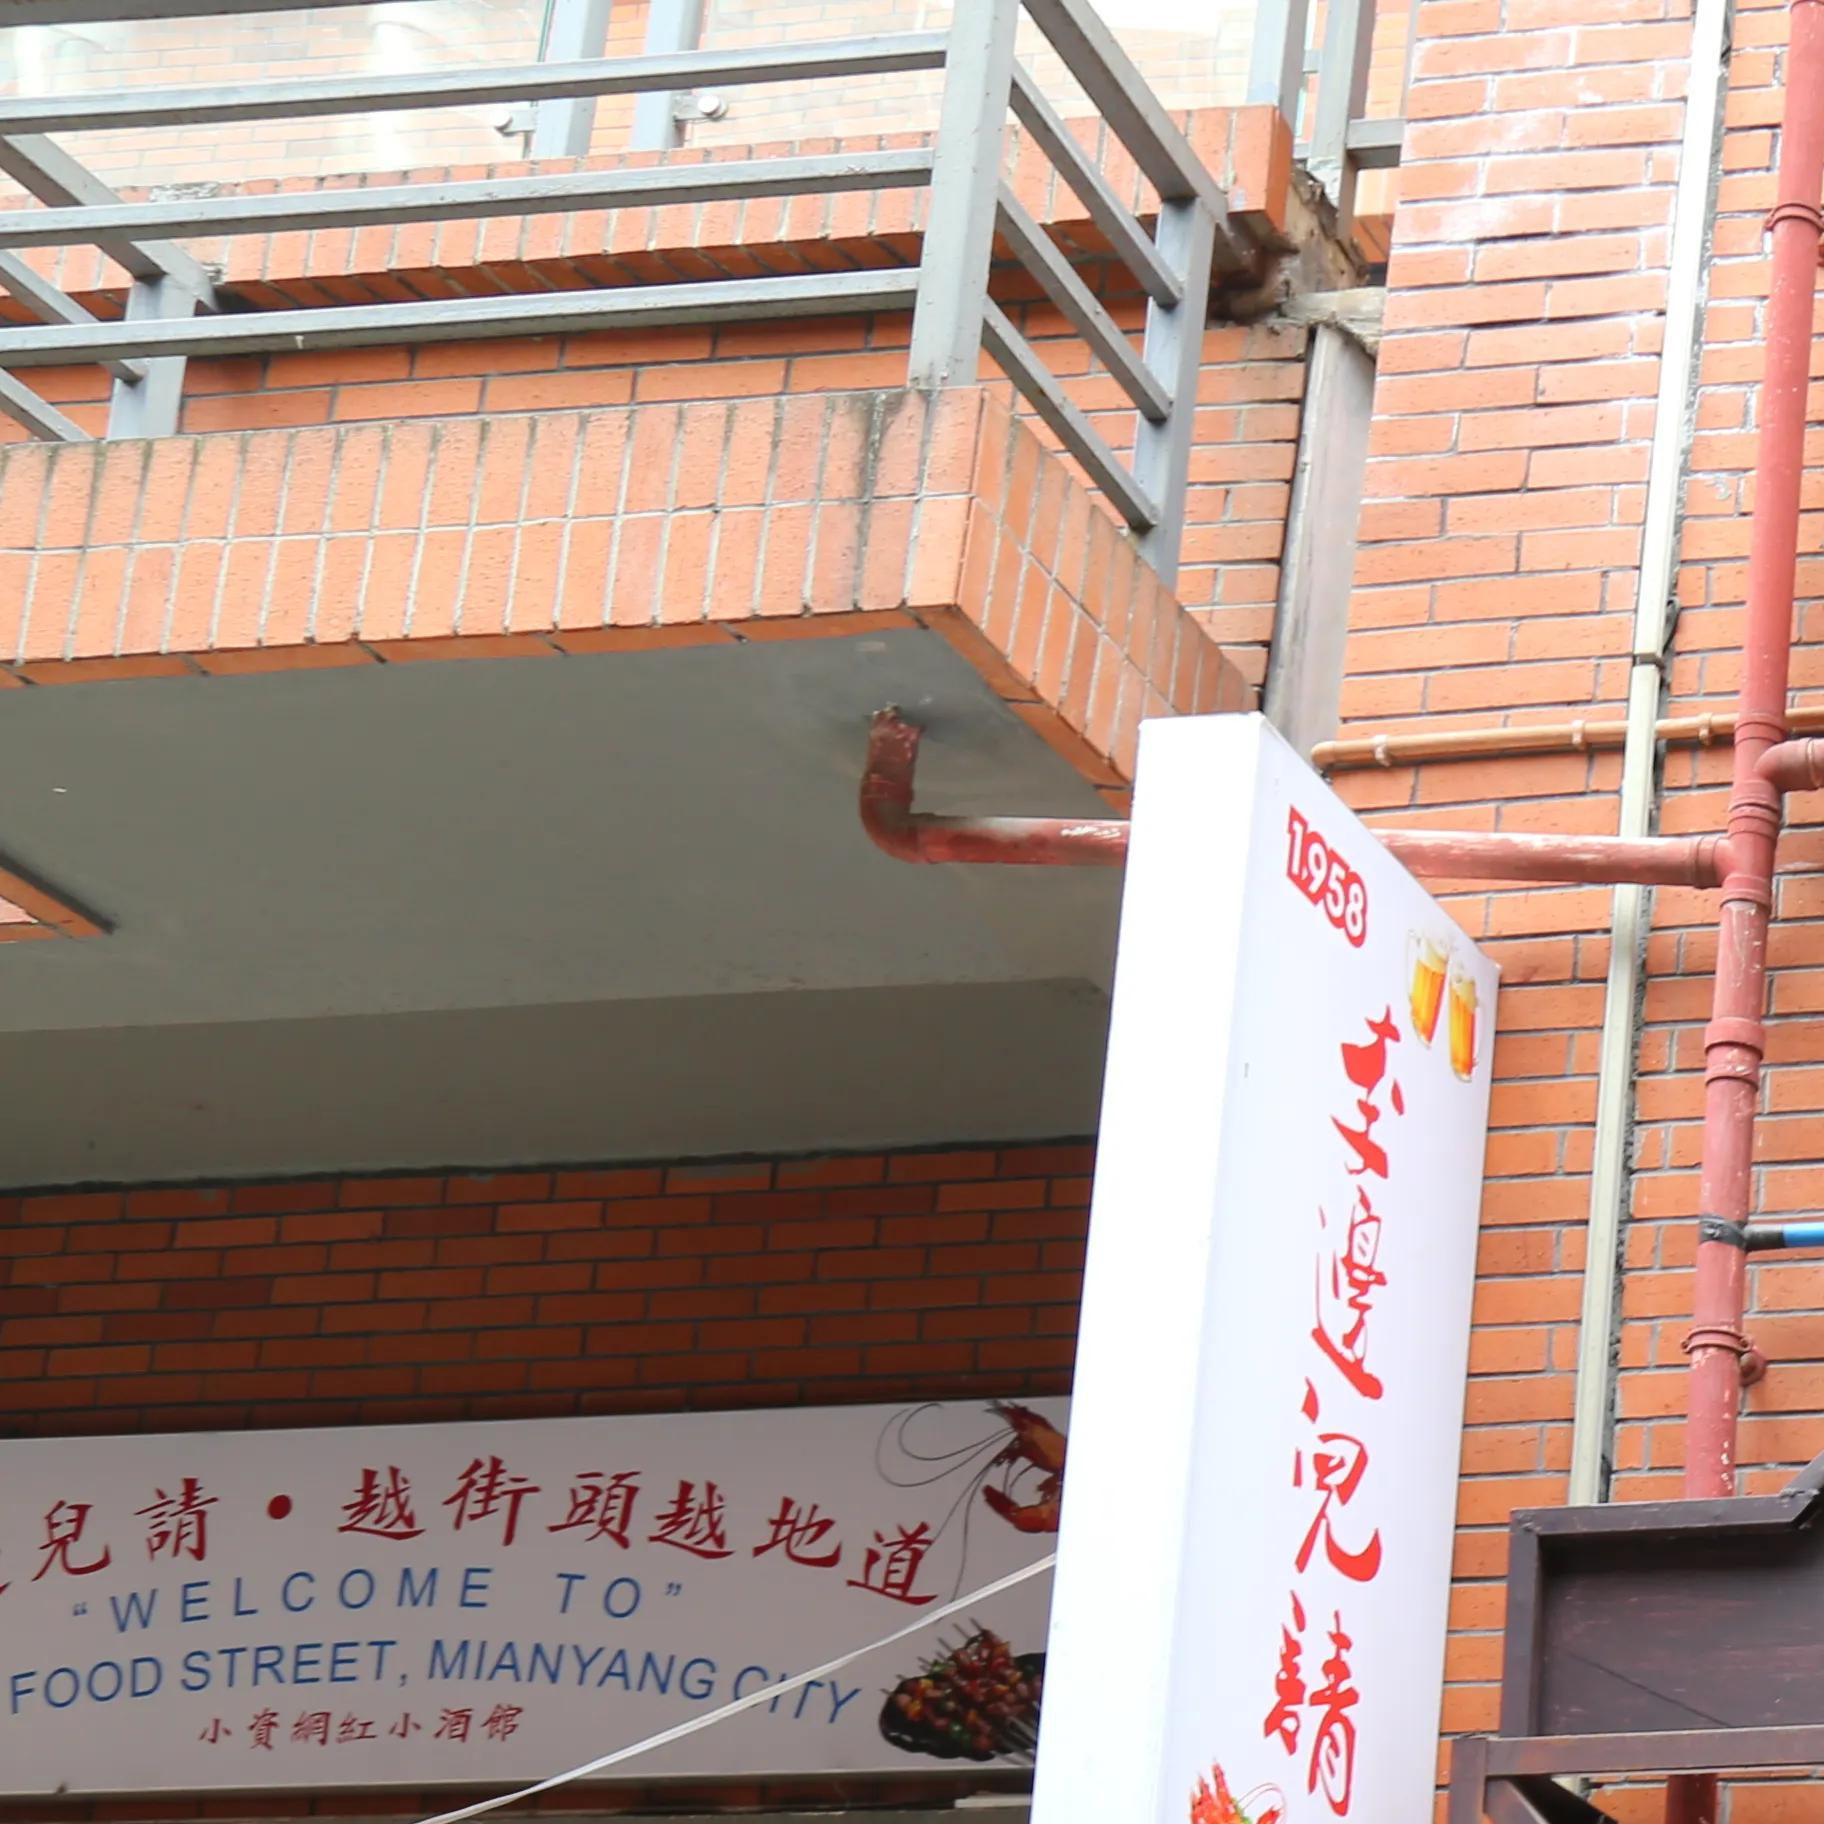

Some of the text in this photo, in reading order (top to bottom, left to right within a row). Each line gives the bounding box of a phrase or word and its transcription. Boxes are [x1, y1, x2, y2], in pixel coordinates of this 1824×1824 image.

[1288, 805, 1367, 946] 1958
[0, 1455, 938, 1606] 兒請·越街頭越地道
[9, 1639, 862, 1724] FOOD STREET, MIANYANG CITY
